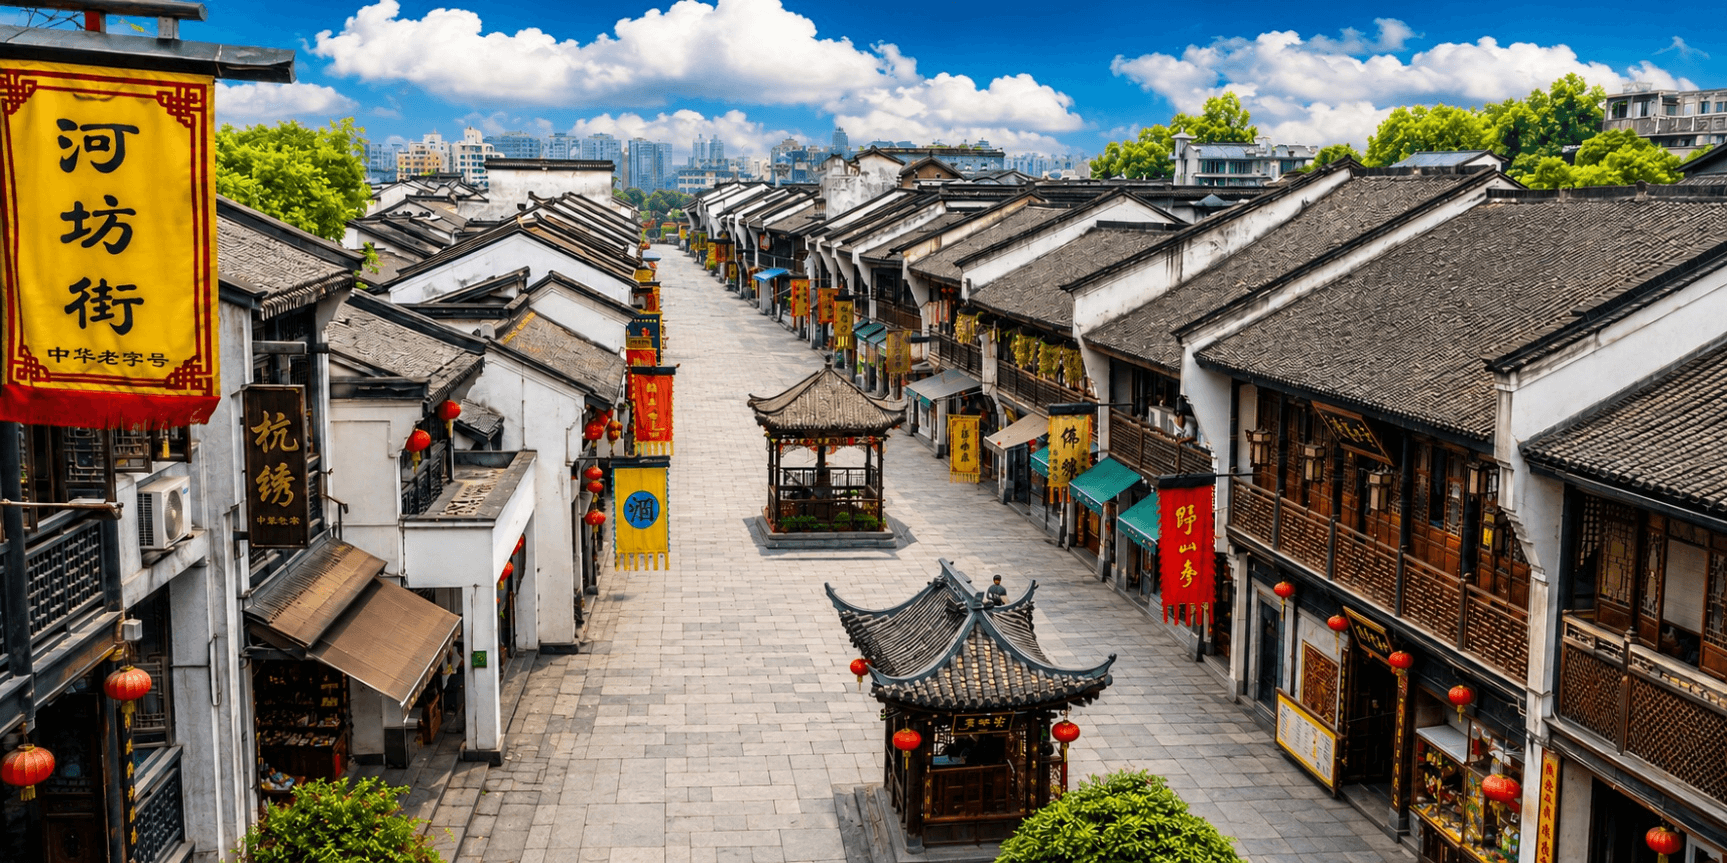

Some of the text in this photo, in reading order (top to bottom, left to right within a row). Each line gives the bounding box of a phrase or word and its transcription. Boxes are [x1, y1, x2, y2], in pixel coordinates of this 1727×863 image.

[56, 118, 145, 336] 河坊街
[47, 346, 170, 368] 中华老字号
[250, 410, 299, 508] 杭绣
